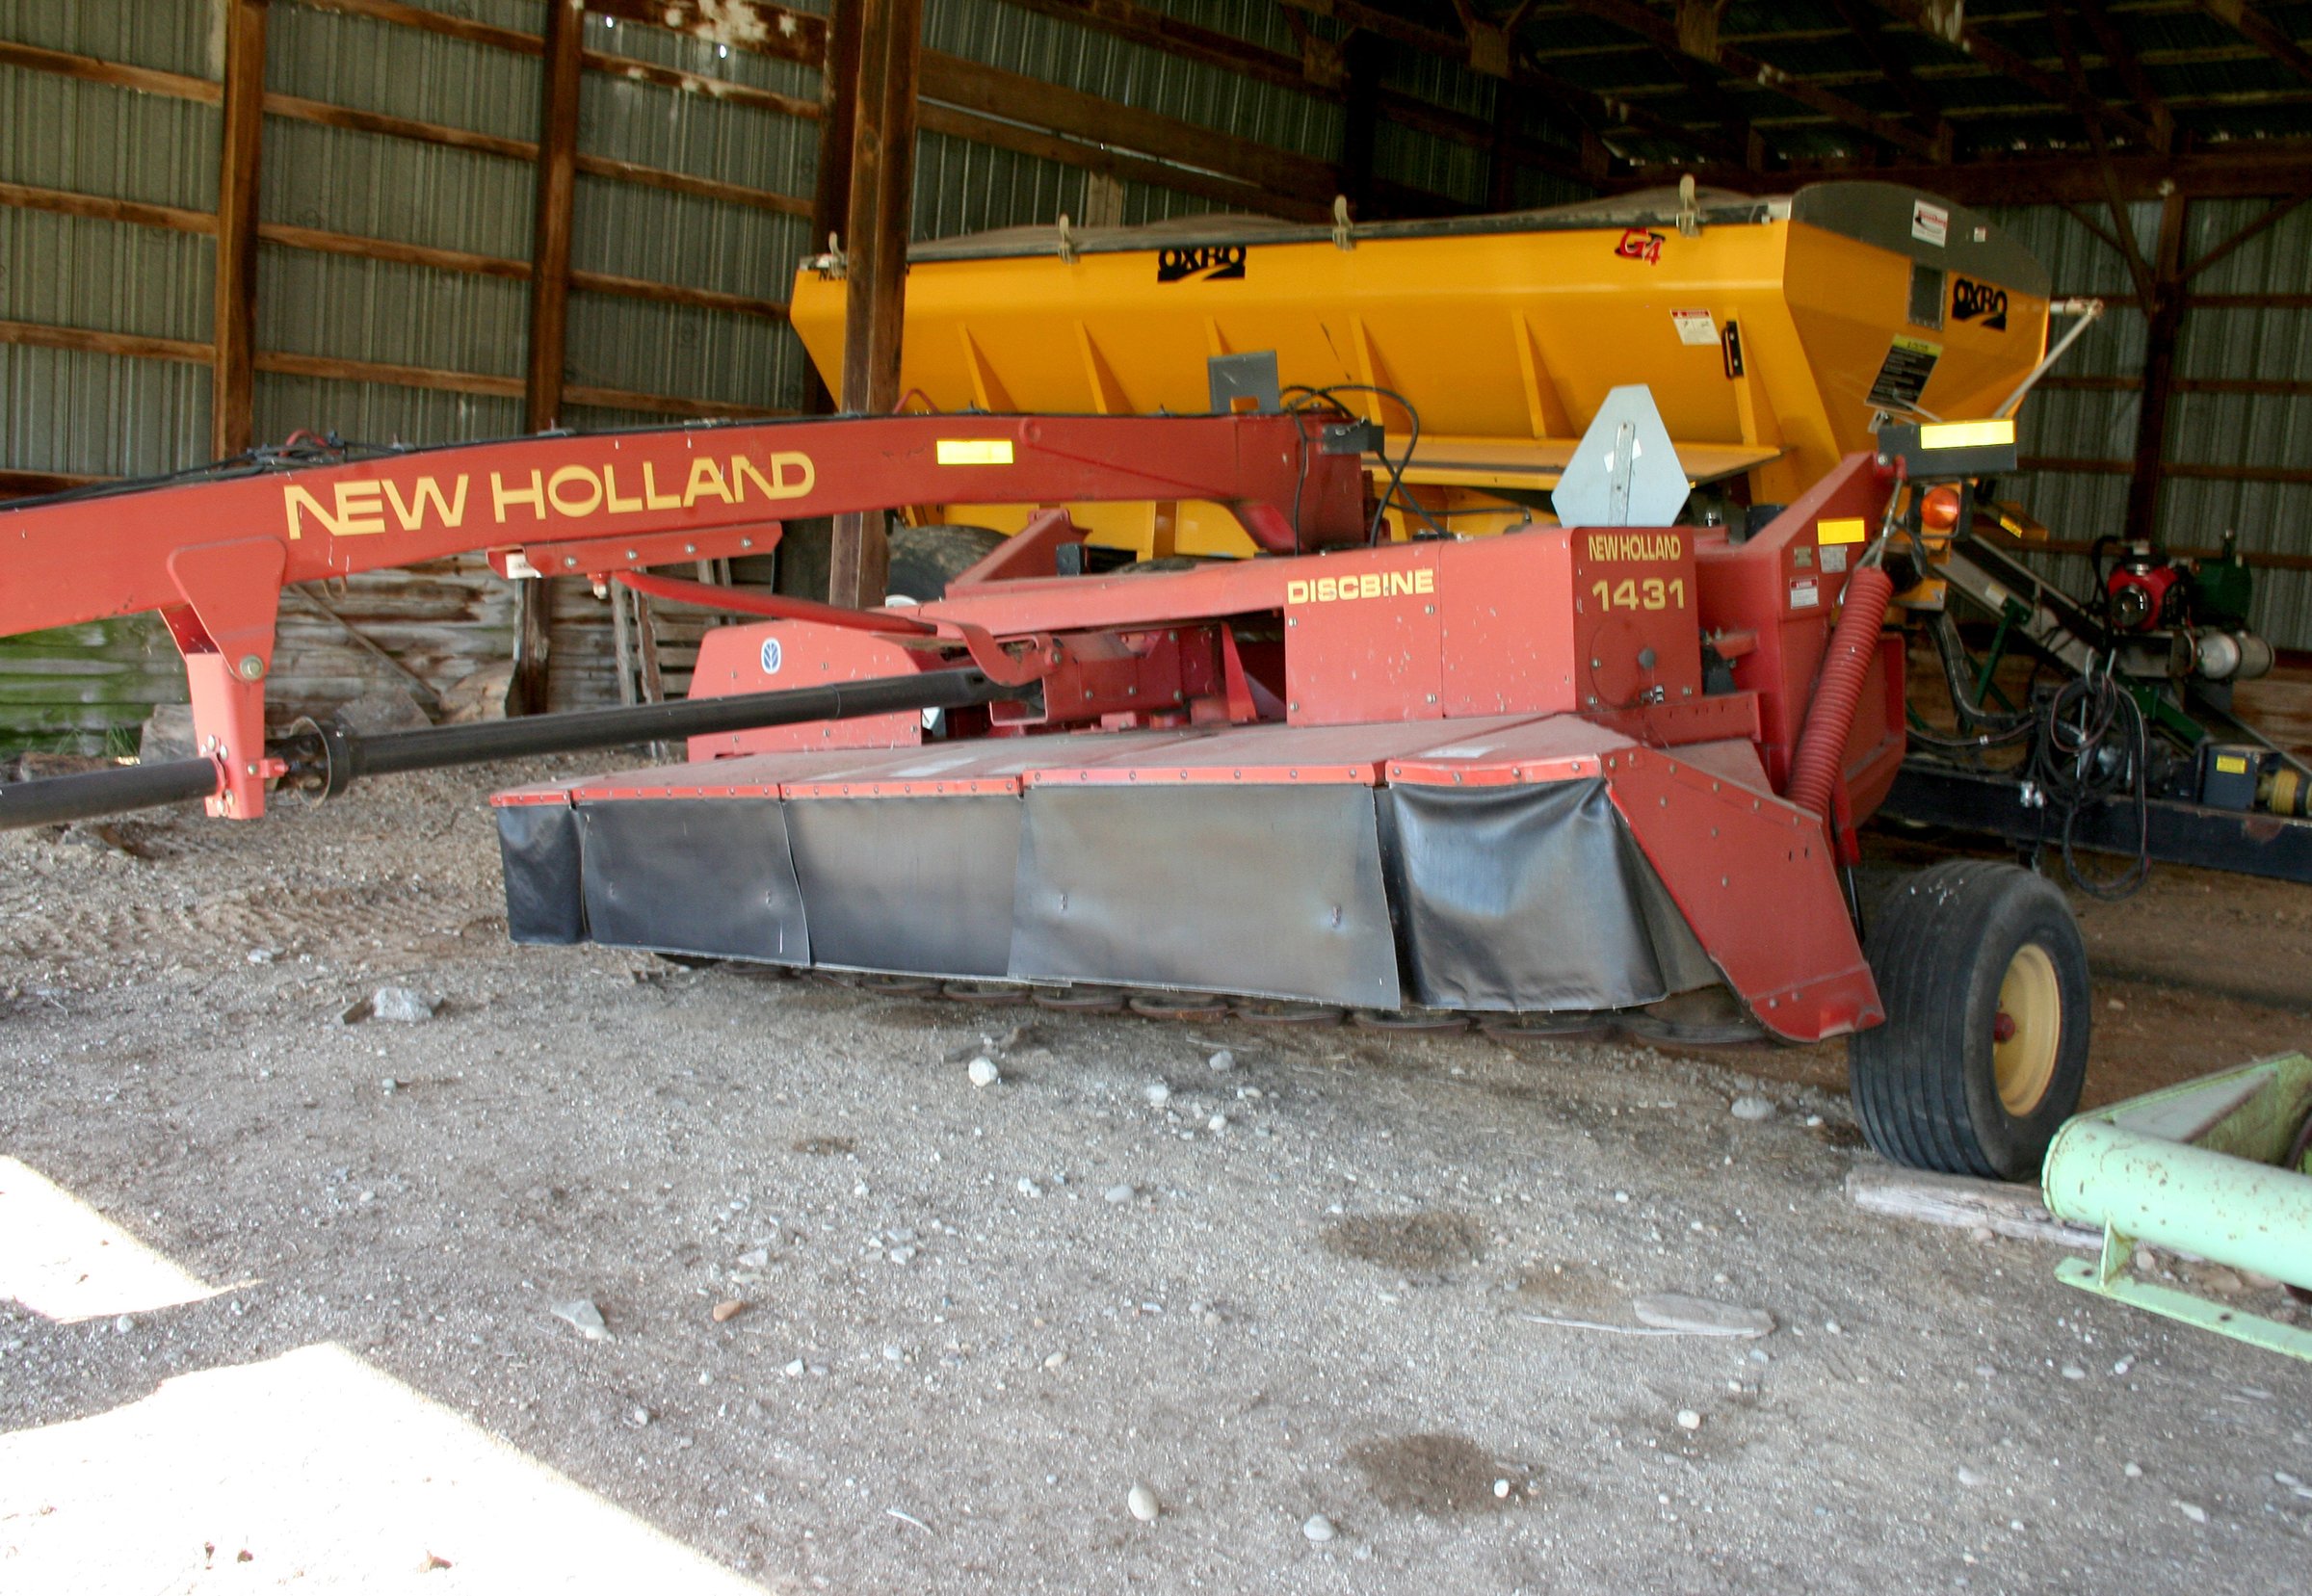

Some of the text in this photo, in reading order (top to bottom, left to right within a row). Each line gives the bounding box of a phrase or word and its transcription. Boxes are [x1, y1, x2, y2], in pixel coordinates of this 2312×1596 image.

[1618, 226, 1663, 266] G4
[1953, 278, 2008, 326] OXBO
[282, 450, 816, 540] NEW HOLLAND
[1588, 533, 1681, 562] NEW HOLLAND
[1286, 567, 1434, 605] DISCBINE
[1591, 577, 1685, 613] 1431
